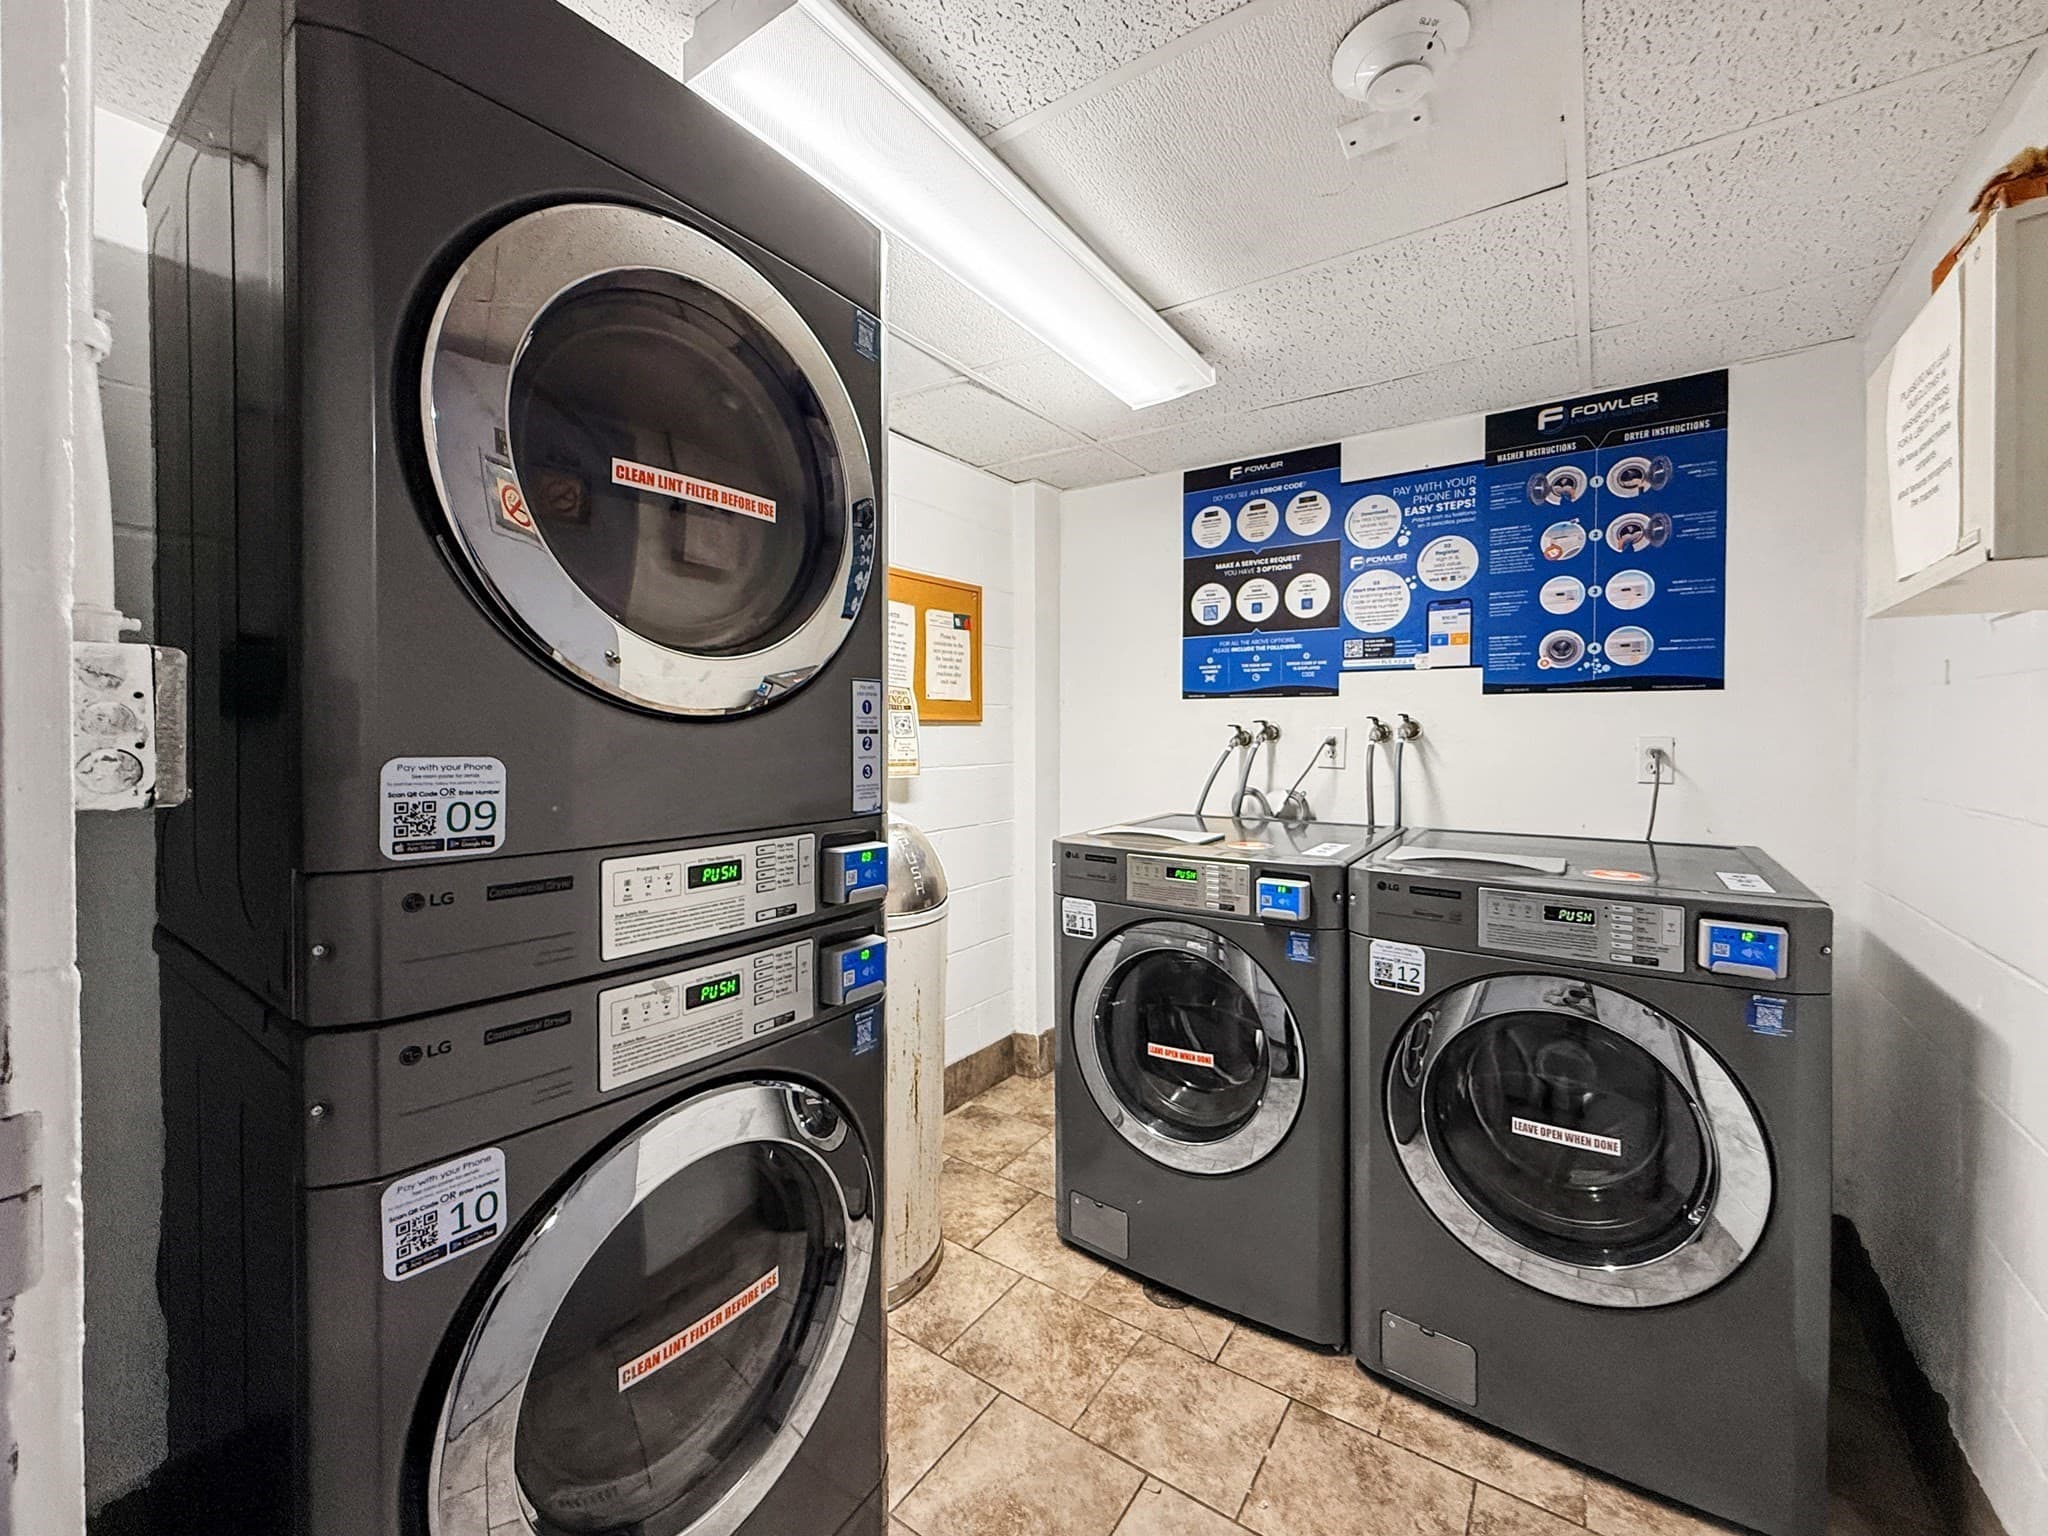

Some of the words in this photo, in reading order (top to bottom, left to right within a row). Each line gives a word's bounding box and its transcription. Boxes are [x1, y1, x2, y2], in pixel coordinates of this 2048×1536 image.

[1570, 392, 1659, 418] FOWLER
[1624, 429, 1649, 441] DRYER
[1651, 419, 1710, 437] INSTRUCTIONS
[1497, 450, 1524, 463] WASHER
[1525, 442, 1577, 457] INSTRUCTIONS
[1244, 461, 1283, 473] FOWLER
[615, 465, 655, 486] CLEAN
[658, 474, 683, 493] LINT
[685, 482, 719, 502] FILTER
[721, 491, 756, 512] BEFORE
[758, 502, 774, 518] USE
[1393, 486, 1411, 497] PAY
[1414, 481, 1442, 493] WITH
[1445, 475, 1476, 488] YOUR
[1413, 490, 1452, 504] PHONE
[1454, 489, 1465, 498] IN
[1468, 486, 1476, 496] 3
[1404, 504, 1434, 517] EASY
[1435, 498, 1476, 512] STEPS!
[1215, 561, 1234, 570] MAKE
[1241, 558, 1269, 567] SERVICE
[1366, 553, 1407, 563] FOWLER
[396, 764, 415, 772] Pay
[440, 764, 461, 772] your
[463, 763, 493, 771] Phone
[439, 787, 456, 796] OR
[446, 800, 497, 832] 09
[702, 865, 738, 883] PUSH
[898, 838, 926, 896] PUSH
[1175, 869, 1197, 880] PUSH
[430, 891, 455, 907] LG
[1079, 916, 1093, 930] 11
[1558, 910, 1592, 922] PUSH
[1397, 966, 1420, 984] 12
[701, 980, 736, 1001] PUSH
[427, 1040, 452, 1058] LG
[1514, 1120, 1538, 1135] LEAVE
[1540, 1127, 1562, 1140] OPEN
[1564, 1133, 1591, 1146] WHEN
[1594, 1138, 1618, 1152] DONE
[396, 1184, 415, 1194] Pay
[418, 1175, 438, 1186] with
[440, 1167, 461, 1180] your
[463, 1155, 492, 1169] Phone
[440, 1191, 457, 1203] OR
[450, 1191, 498, 1235] 10
[622, 1351, 660, 1384] CLEAN
[663, 1333, 688, 1360] LINT
[690, 1311, 723, 1343] FILTER
[724, 1286, 759, 1319] BEFORE
[760, 1272, 777, 1294] USE
